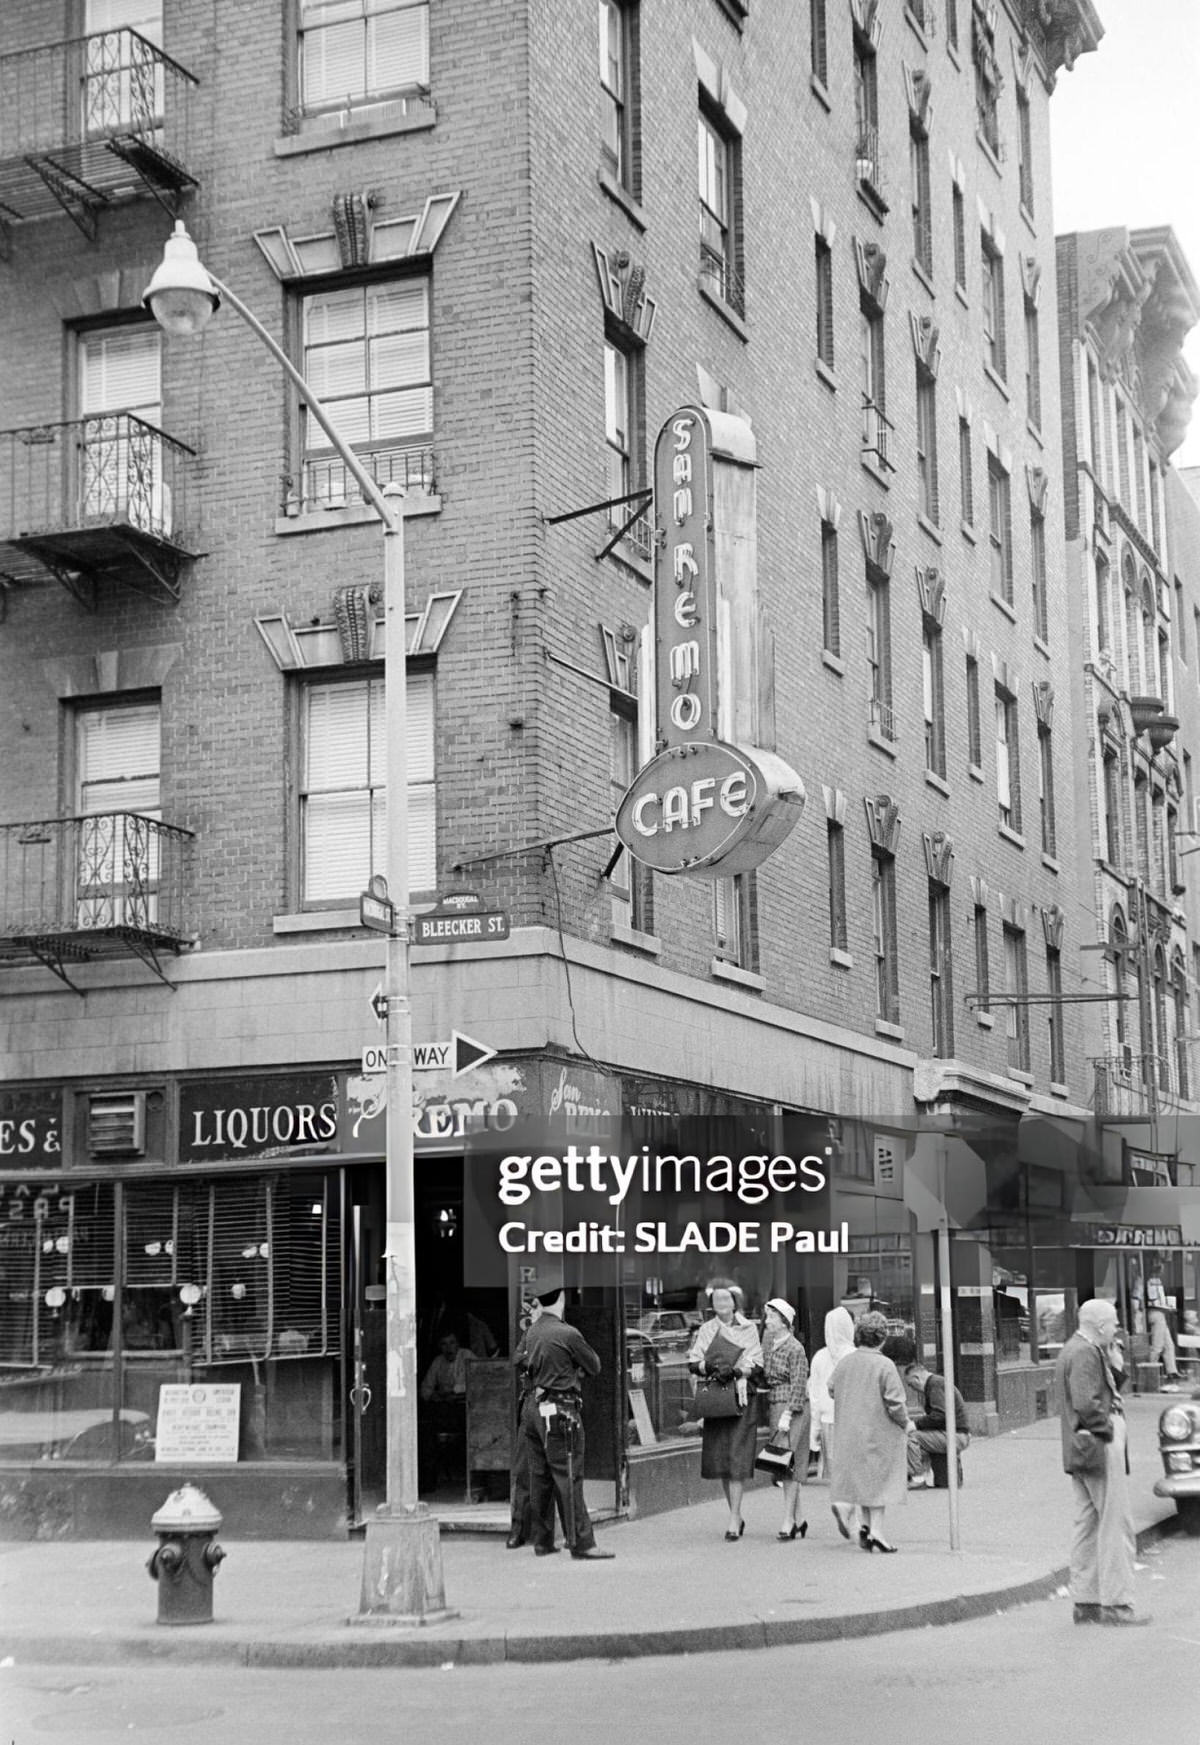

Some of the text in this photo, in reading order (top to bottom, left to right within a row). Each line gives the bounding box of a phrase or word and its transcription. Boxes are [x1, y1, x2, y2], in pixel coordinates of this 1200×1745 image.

[672, 418, 693, 524] SAN
[631, 771, 748, 838] CAFE
[422, 916, 505, 938] BLEECKER ST.
[365, 1047, 449, 1068] ON WAY
[191, 1103, 336, 1148] LIQUORS
